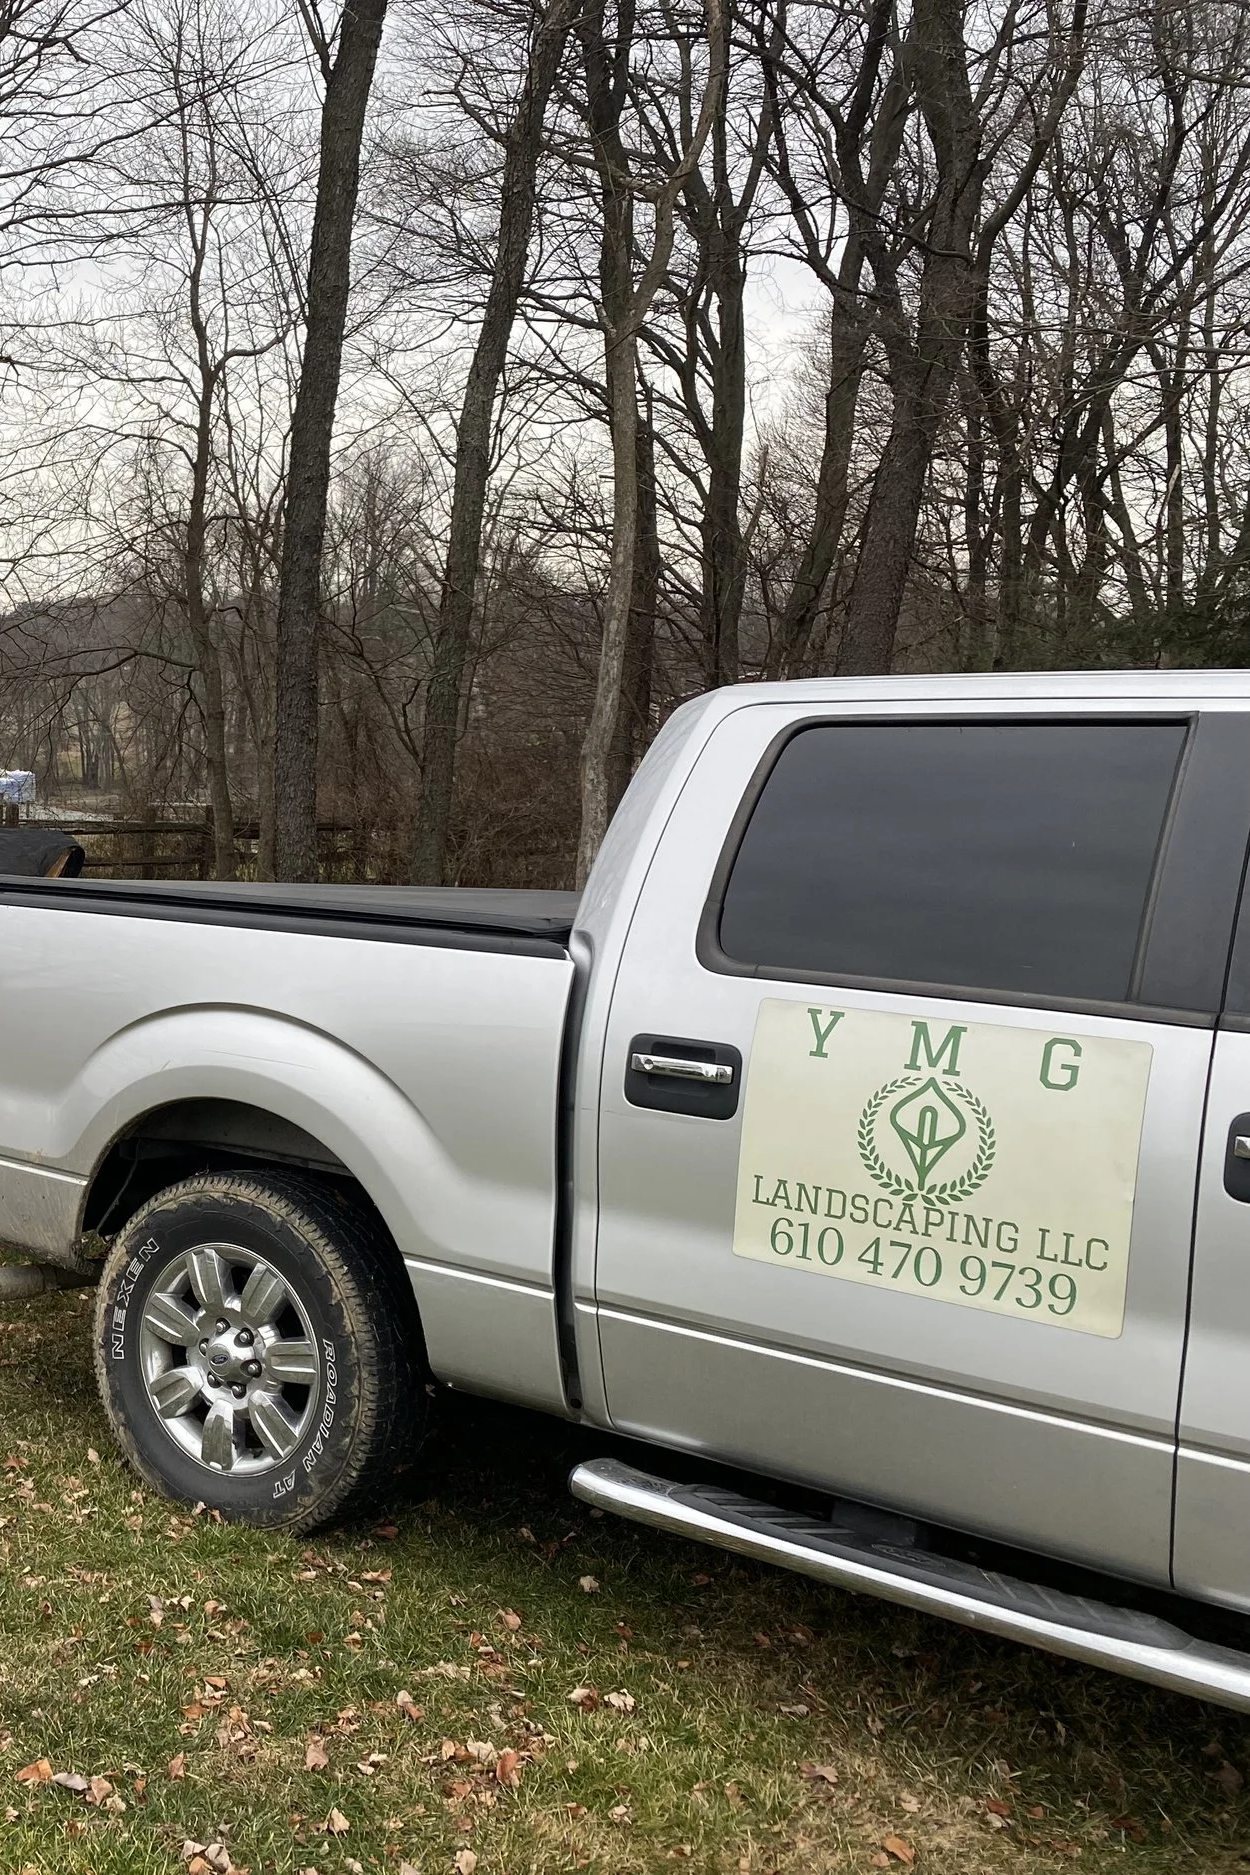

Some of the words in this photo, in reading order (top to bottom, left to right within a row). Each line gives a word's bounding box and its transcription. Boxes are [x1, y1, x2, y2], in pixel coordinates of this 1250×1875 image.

[807, 1008, 845, 1058] Y
[903, 1021, 968, 1076] M
[1040, 1037, 1083, 1091] G
[752, 1175, 1020, 1254] LANDSCAPING
[1036, 1228, 1110, 1271] LLC
[770, 1217, 845, 1266] 610
[857, 1237, 942, 1287] 470
[959, 1256, 1078, 1316] 9739
[111, 1238, 160, 1360] NEXEN
[303, 1338, 338, 1473] ROADIAN
[273, 1469, 296, 1499] AT
